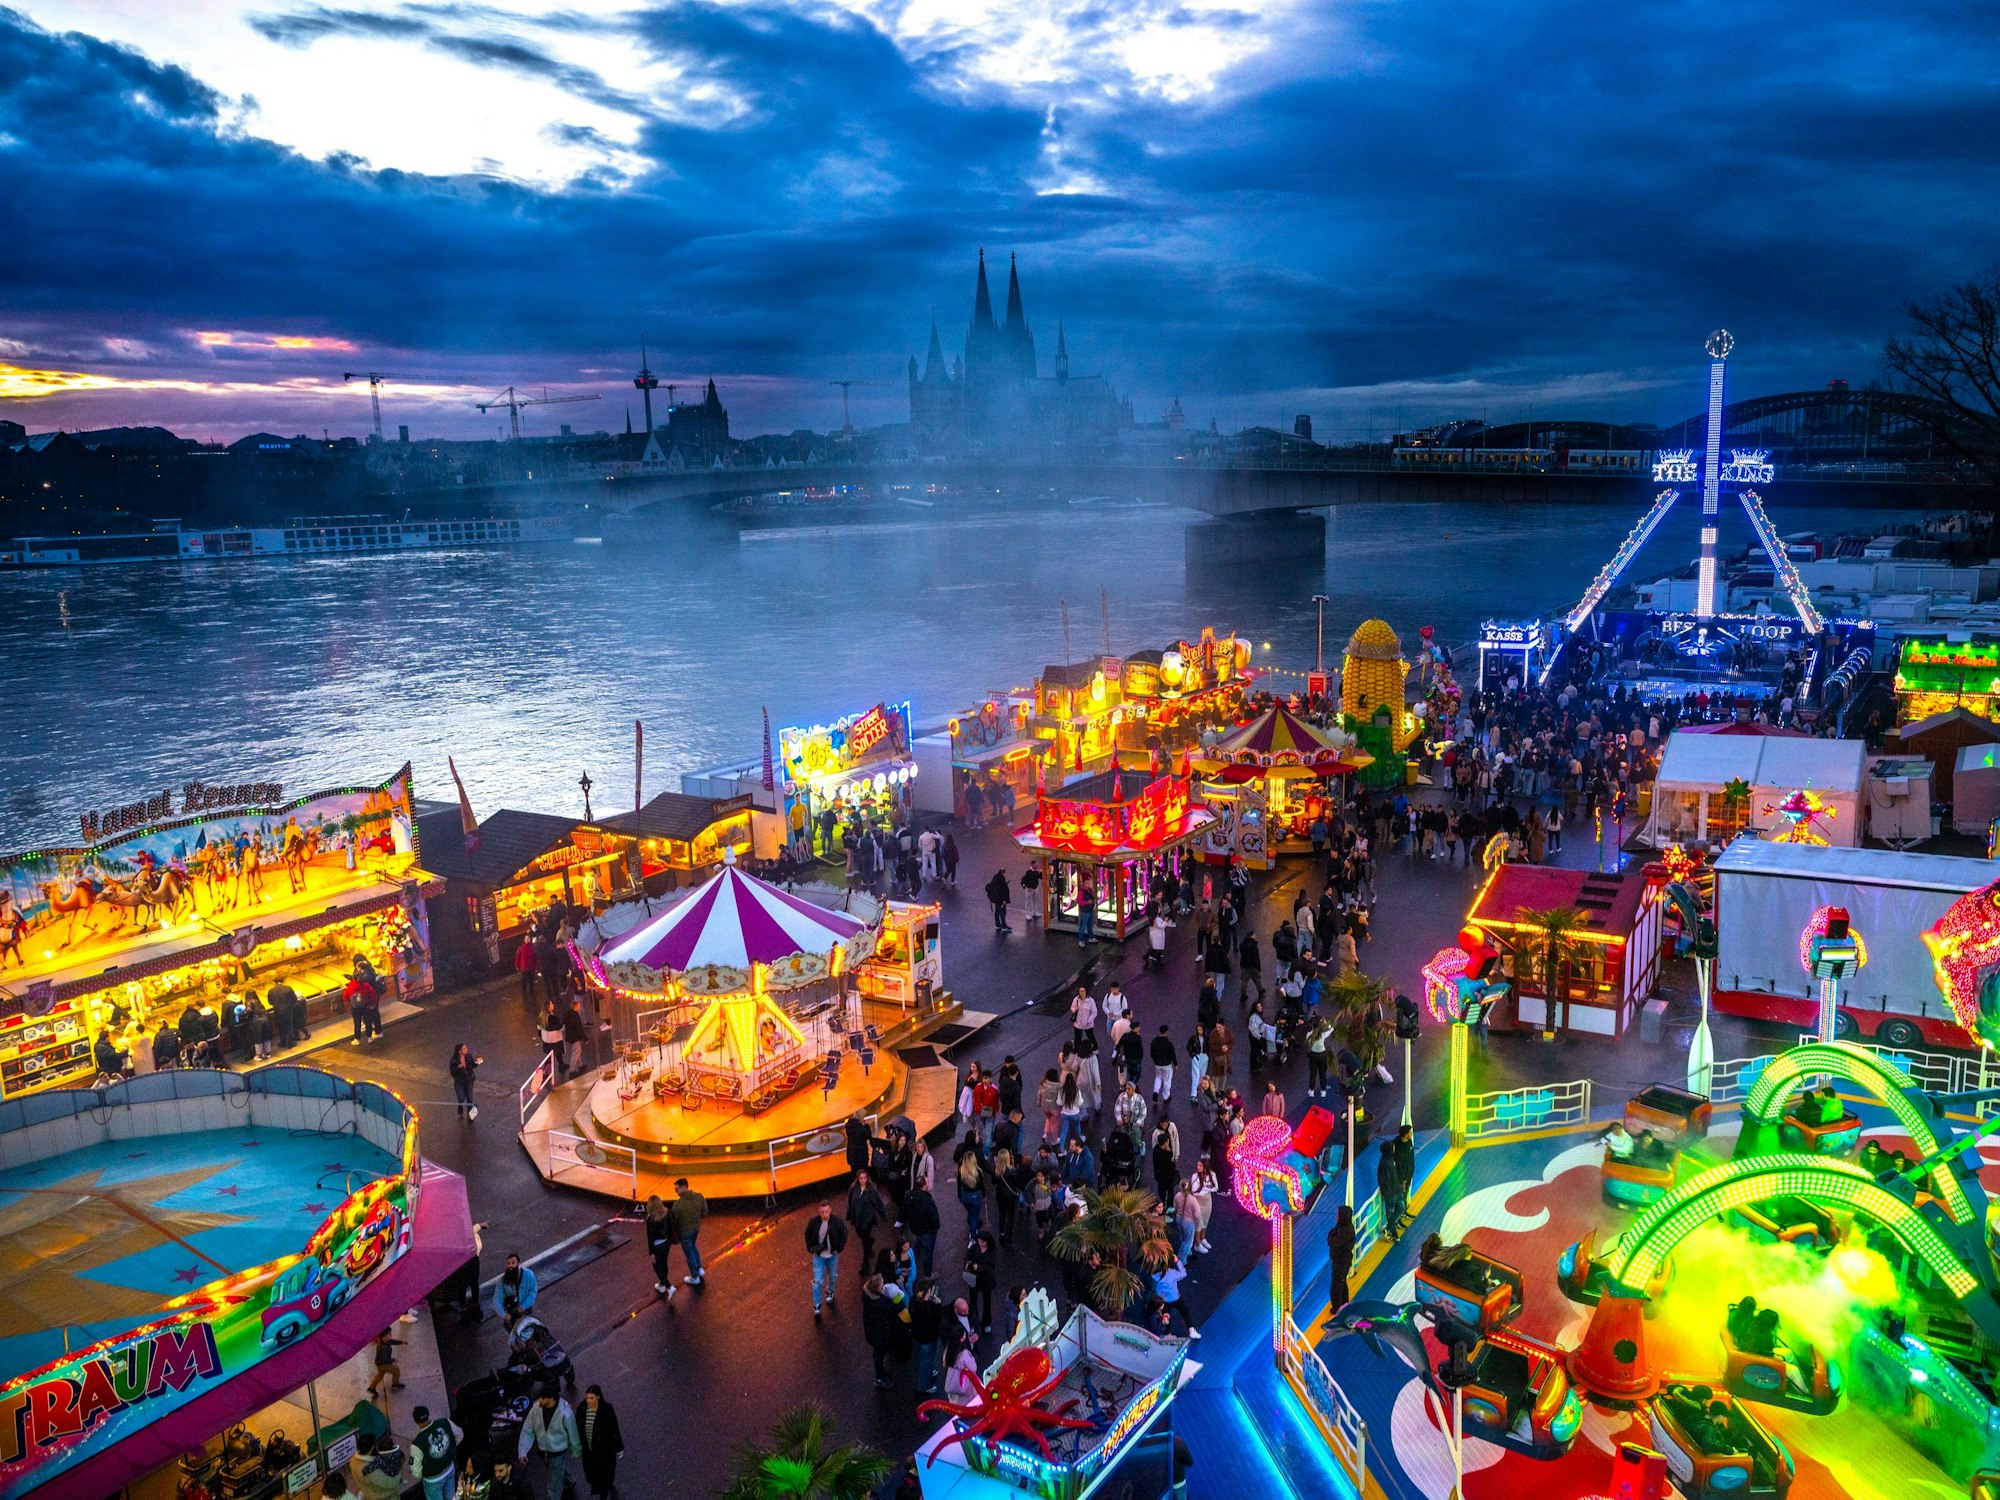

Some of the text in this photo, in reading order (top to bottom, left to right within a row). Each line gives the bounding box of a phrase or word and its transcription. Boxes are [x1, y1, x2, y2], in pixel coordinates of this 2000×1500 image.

[1652, 463, 1774, 483] THE KING
[1486, 631, 1524, 641] KASSE
[852, 718, 889, 757] SOCCER
[80, 781, 283, 843] Kamel Rennen
[0, 1321, 223, 1464] TRAUM
